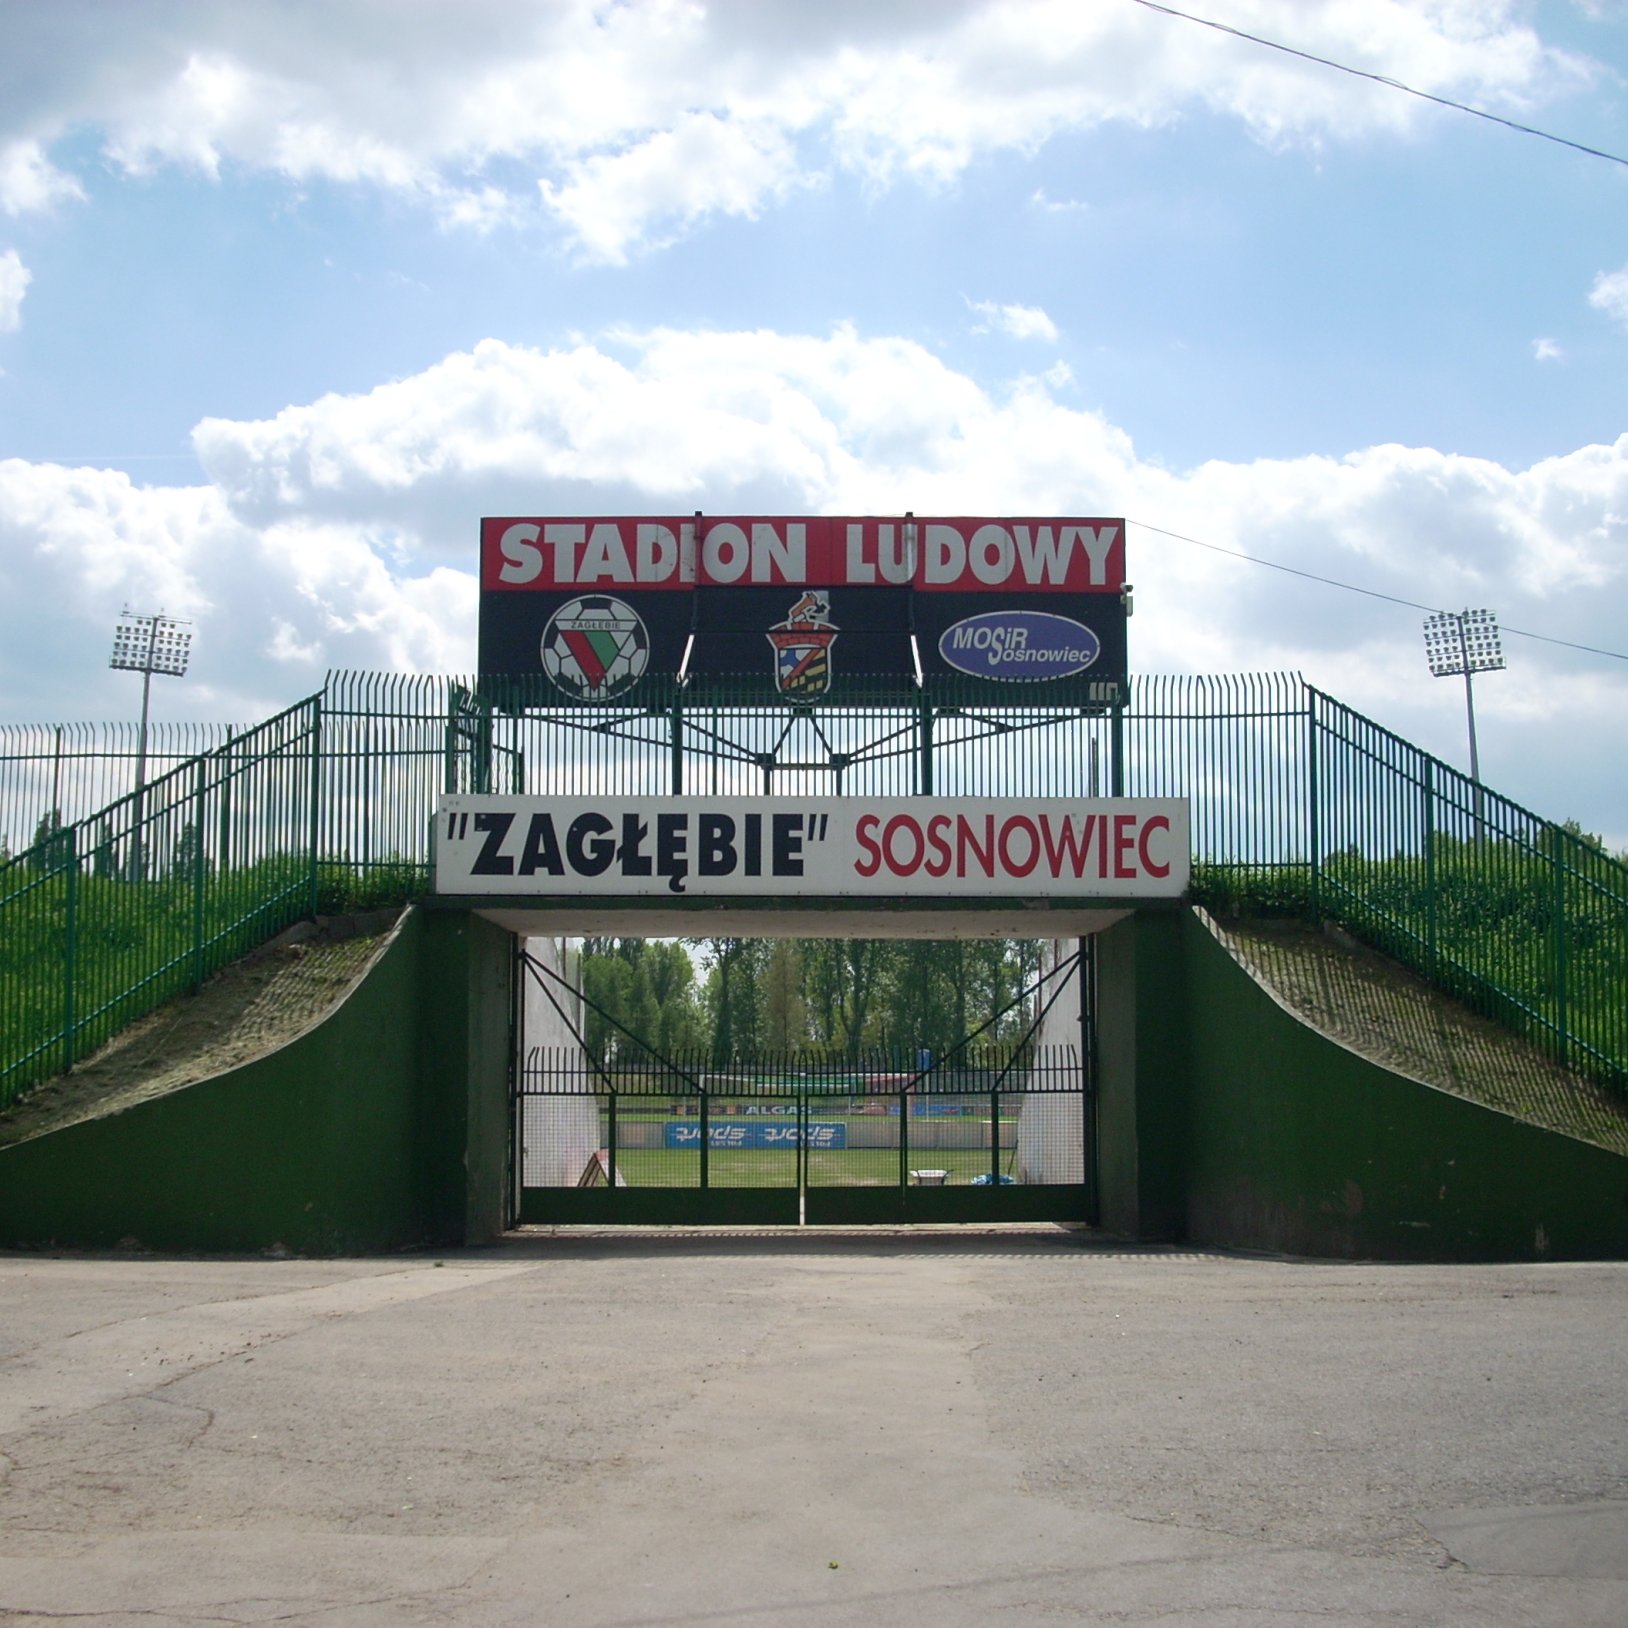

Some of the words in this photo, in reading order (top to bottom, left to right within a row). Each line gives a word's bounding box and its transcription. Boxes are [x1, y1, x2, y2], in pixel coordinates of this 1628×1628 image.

[499, 522, 806, 584] STADION
[846, 523, 1119, 585] LUDOWY
[953, 627, 1028, 664] MOSiR
[447, 812, 829, 893] "ZAGŁĘBIE"
[854, 814, 1170, 878] SOSNOWIEC
